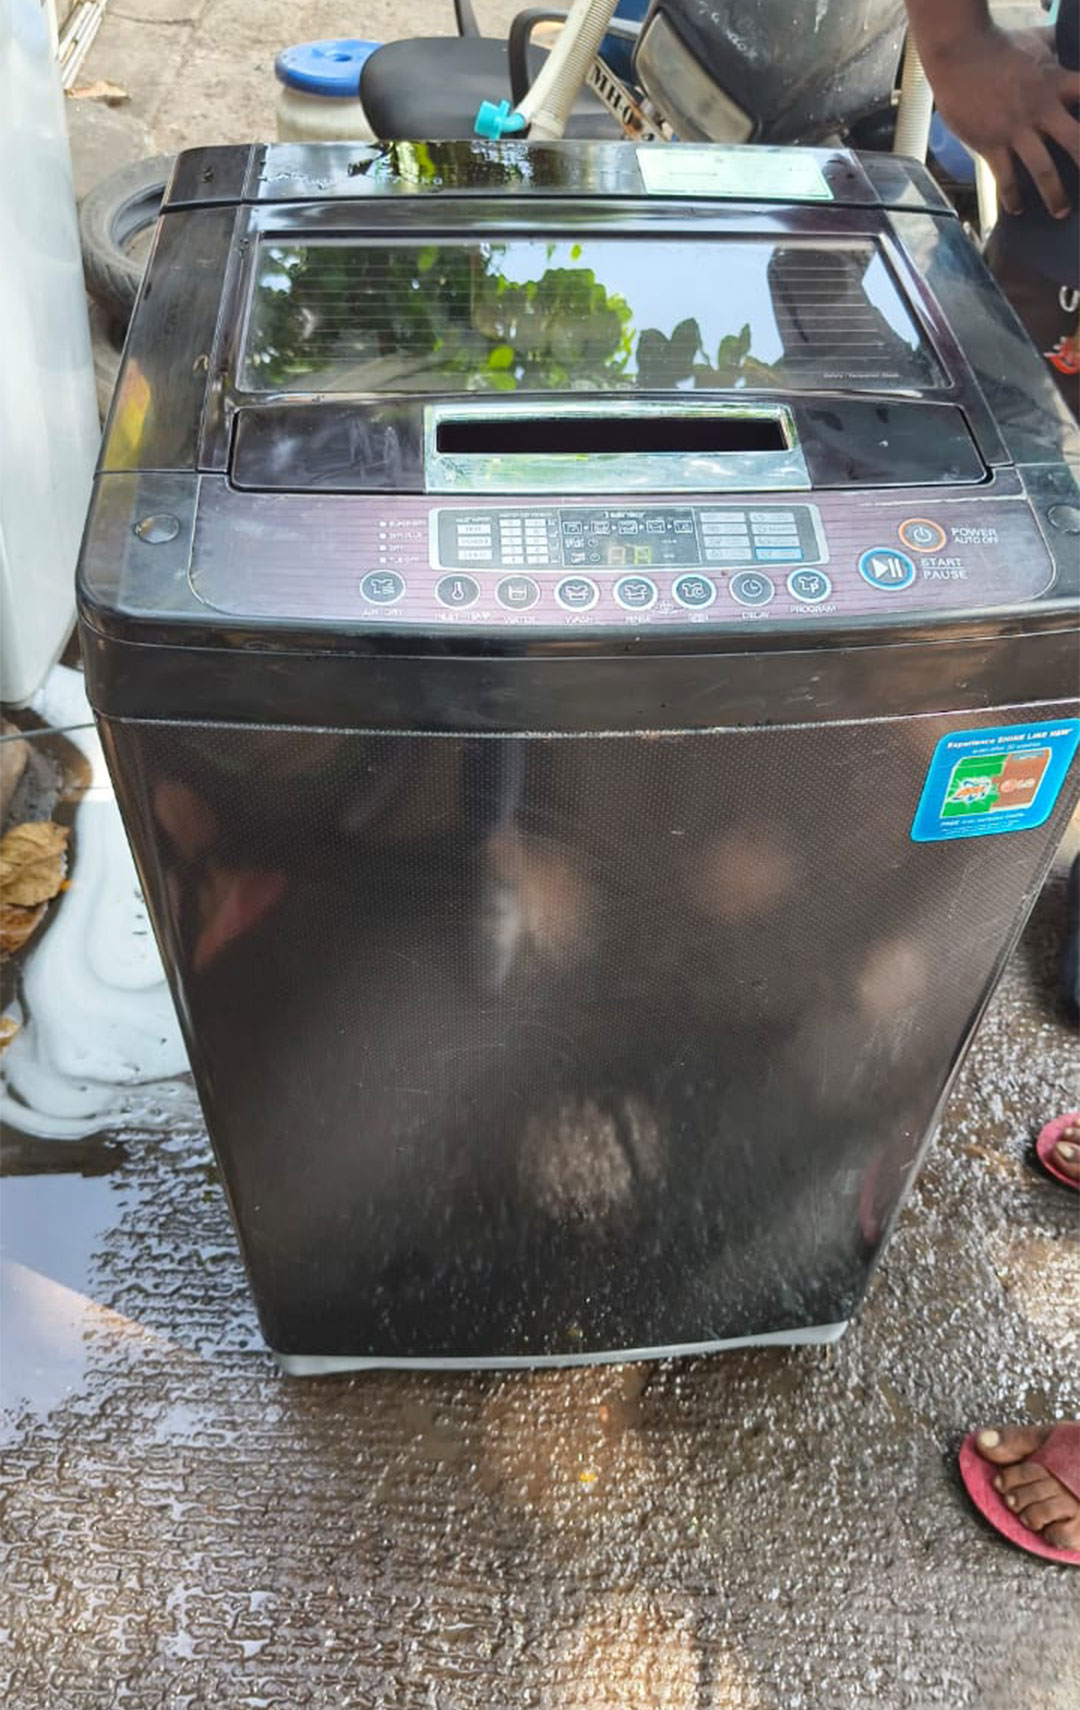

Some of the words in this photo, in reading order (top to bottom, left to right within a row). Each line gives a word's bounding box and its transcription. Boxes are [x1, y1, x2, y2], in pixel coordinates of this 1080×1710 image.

[951, 527, 997, 537] POWER
[954, 535, 981, 544] AUTO
[982, 535, 998, 544] OFF
[920, 557, 962, 567] START
[922, 568, 968, 580] PAUSE
[789, 603, 836, 615] PROGRAM
[947, 738, 996, 750] Experience
